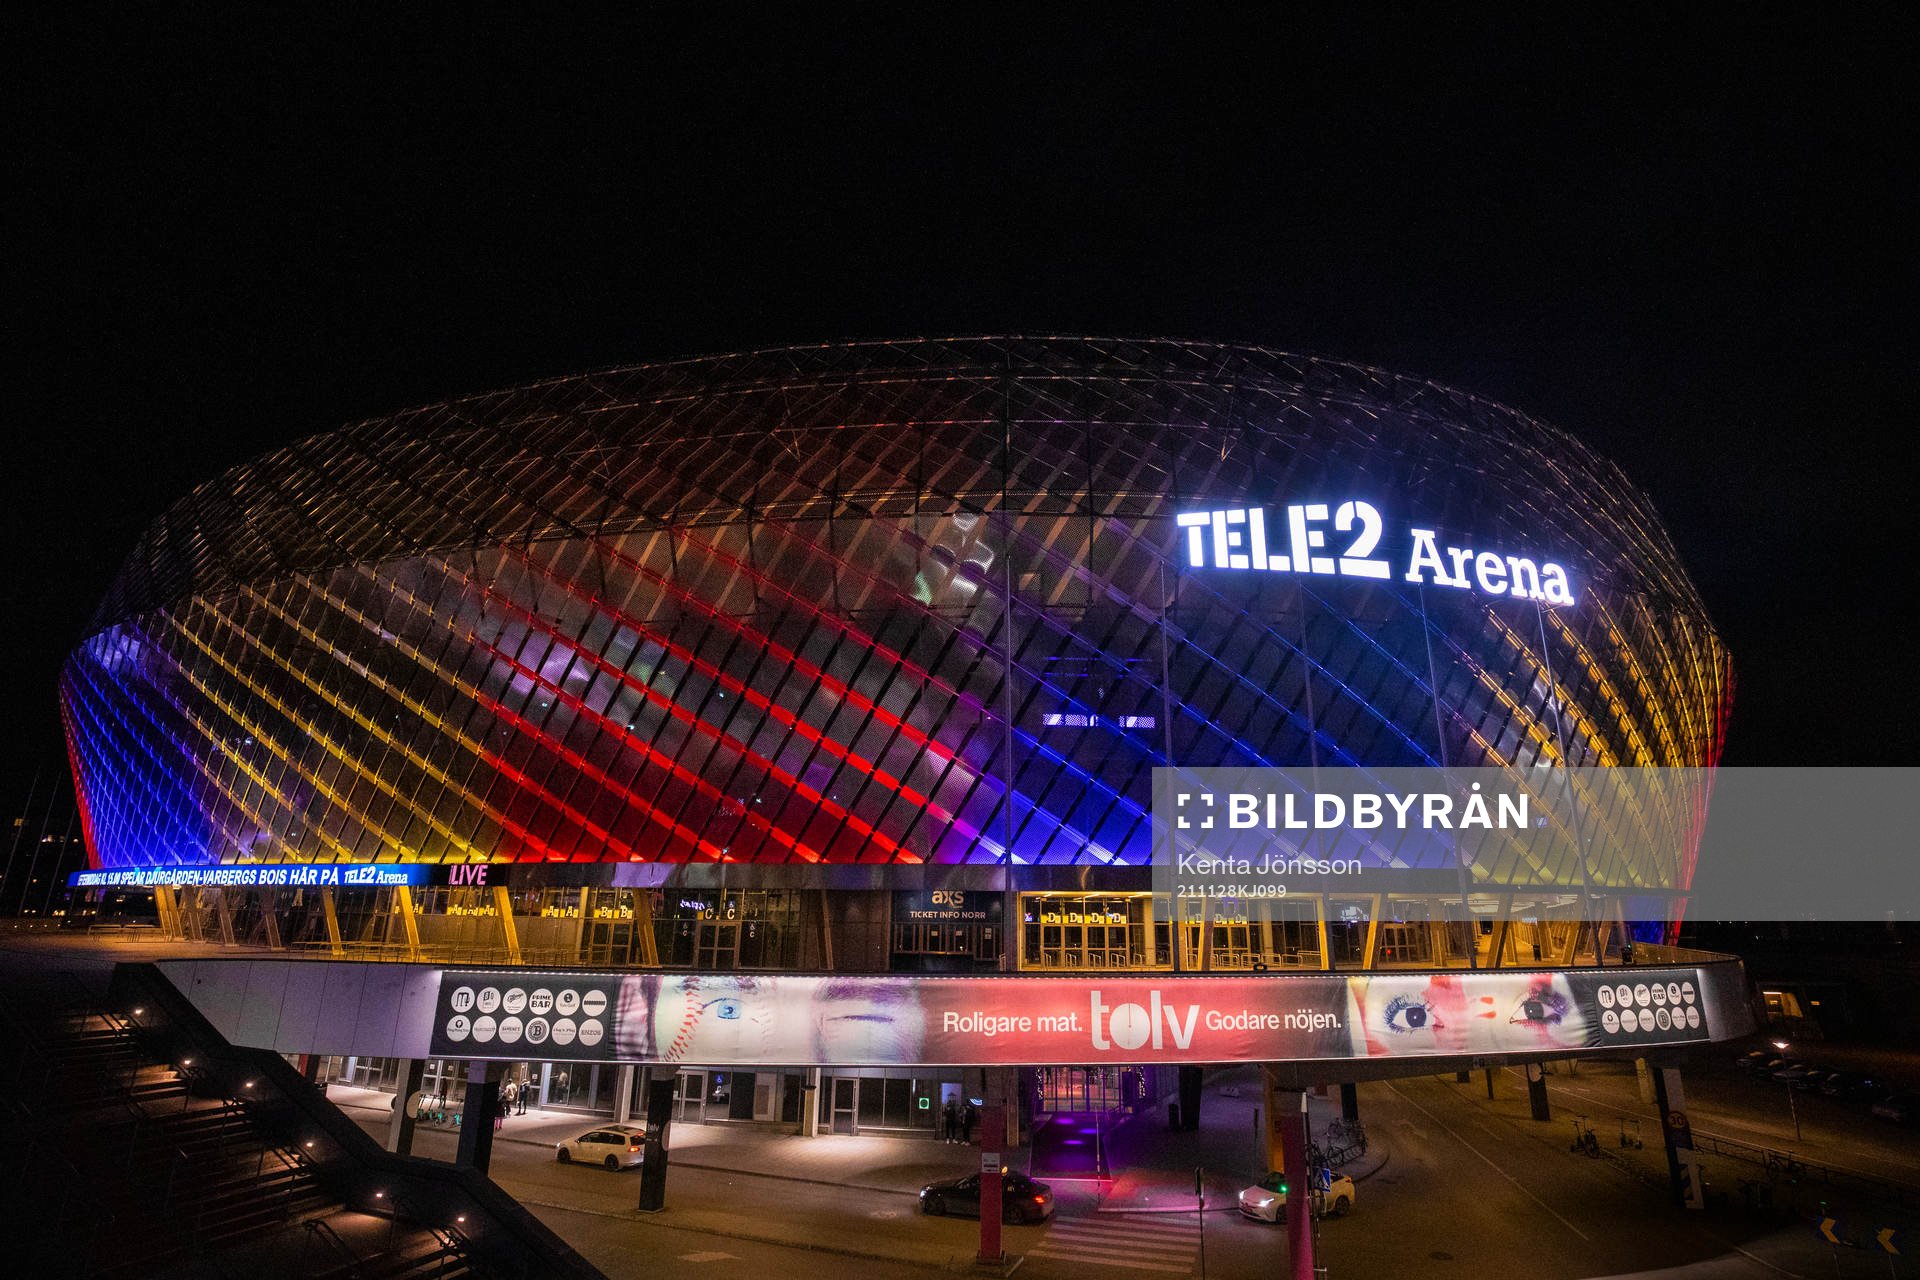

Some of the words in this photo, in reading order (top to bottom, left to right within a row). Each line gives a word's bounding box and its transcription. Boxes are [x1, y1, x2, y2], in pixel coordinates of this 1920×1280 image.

[1177, 500, 1390, 579] TELE2
[1405, 528, 1576, 606] Arena
[120, 871, 146, 886] SPELAR
[145, 868, 257, 886] DJURGÅRDEN-VARBERGS
[258, 869, 287, 885] BOIS
[289, 866, 318, 885] HÄR
[320, 867, 340, 885] PÅ
[344, 866, 376, 884] TELE2
[375, 870, 408, 884] Arena
[450, 864, 488, 886] LIVE
[931, 890, 965, 909] axs
[547, 906, 554, 916] A
[566, 906, 573, 917] A
[601, 907, 609, 917] B
[705, 908, 713, 920] C
[727, 908, 735, 920] C
[910, 911, 938, 919] TICKET
[939, 911, 960, 919] INFO
[961, 911, 986, 919] NORR
[1048, 912, 1055, 922] D
[1070, 912, 1078, 922] D
[1091, 912, 1099, 922] D
[943, 1012, 1032, 1037] Roligare
[1037, 1014, 1083, 1033] mat.
[1090, 990, 1200, 1050] tolv
[1205, 1010, 1280, 1031] Godare
[1284, 1008, 1342, 1033] nöjen.
[533, 1026, 542, 1036] B
